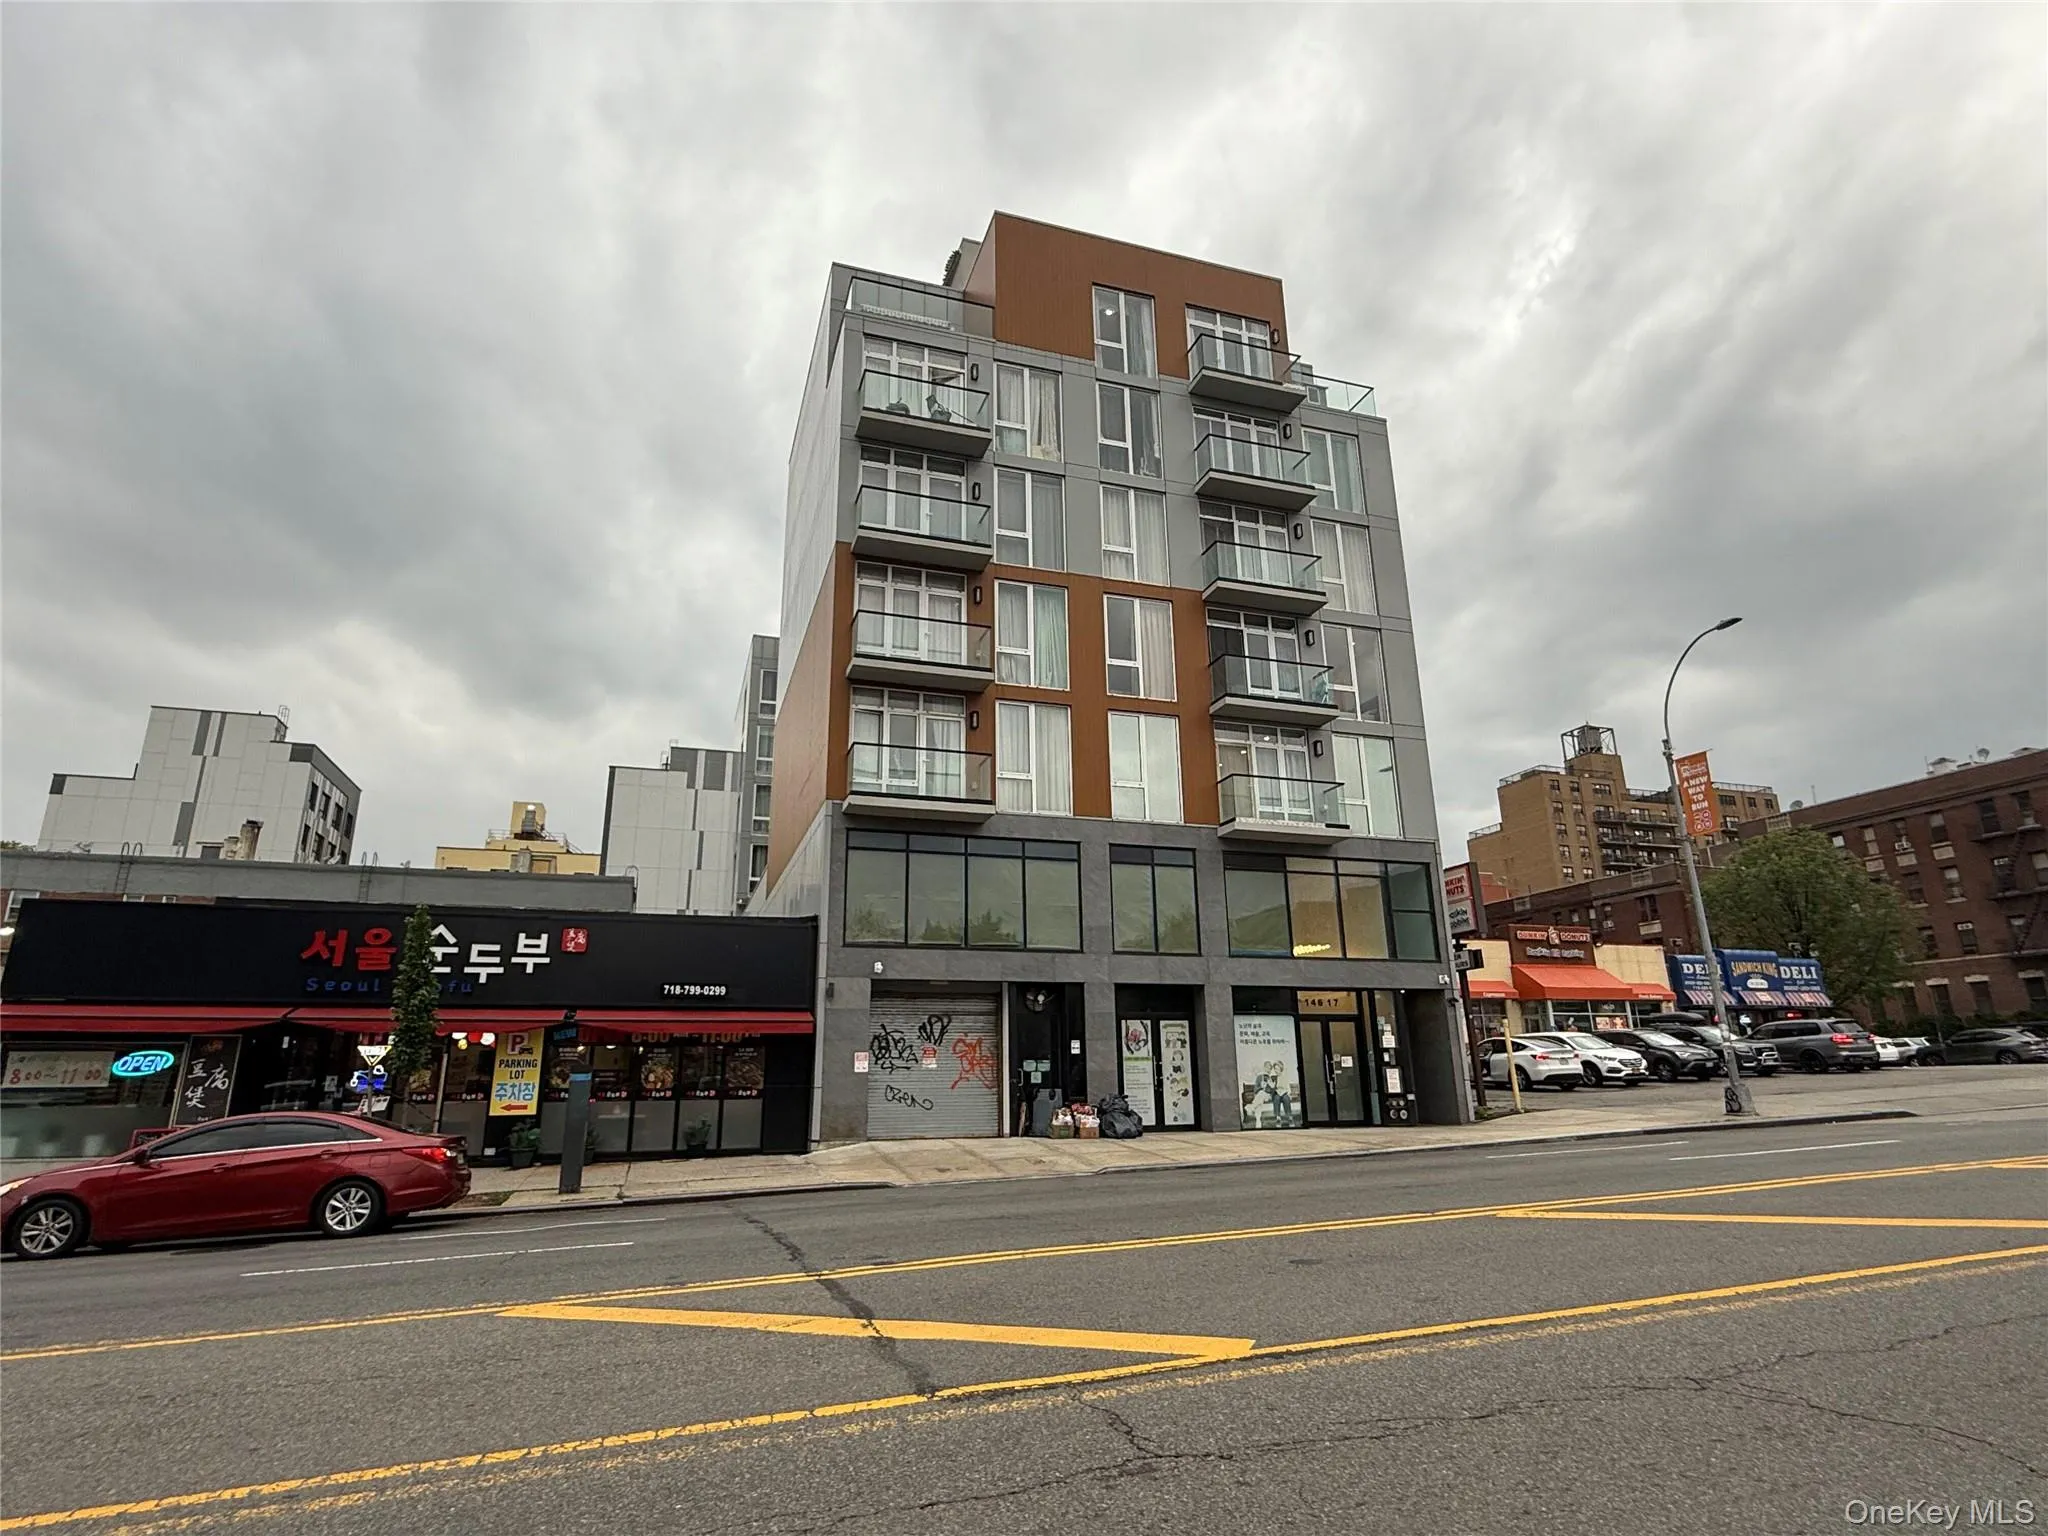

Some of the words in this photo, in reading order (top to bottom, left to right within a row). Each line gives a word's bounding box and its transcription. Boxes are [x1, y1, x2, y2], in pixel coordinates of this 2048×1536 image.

[1688, 784, 1706, 795] WAY
[1692, 793, 1704, 802] TO
[1560, 932, 1590, 942] DONUTS
[301, 927, 398, 971] 서울
[429, 923, 551, 984] 순두부
[1731, 961, 1762, 976] SANDWICH
[1762, 962, 1778, 978] KING
[1779, 966, 1818, 979] DELI
[306, 977, 381, 992] Seoul
[663, 985, 726, 996] 718-799-0299
[118, 1056, 164, 1072] OPEN
[499, 1058, 538, 1069] PARKING
[509, 1069, 526, 1080] LOT
[495, 1082, 536, 1102] 주차장
